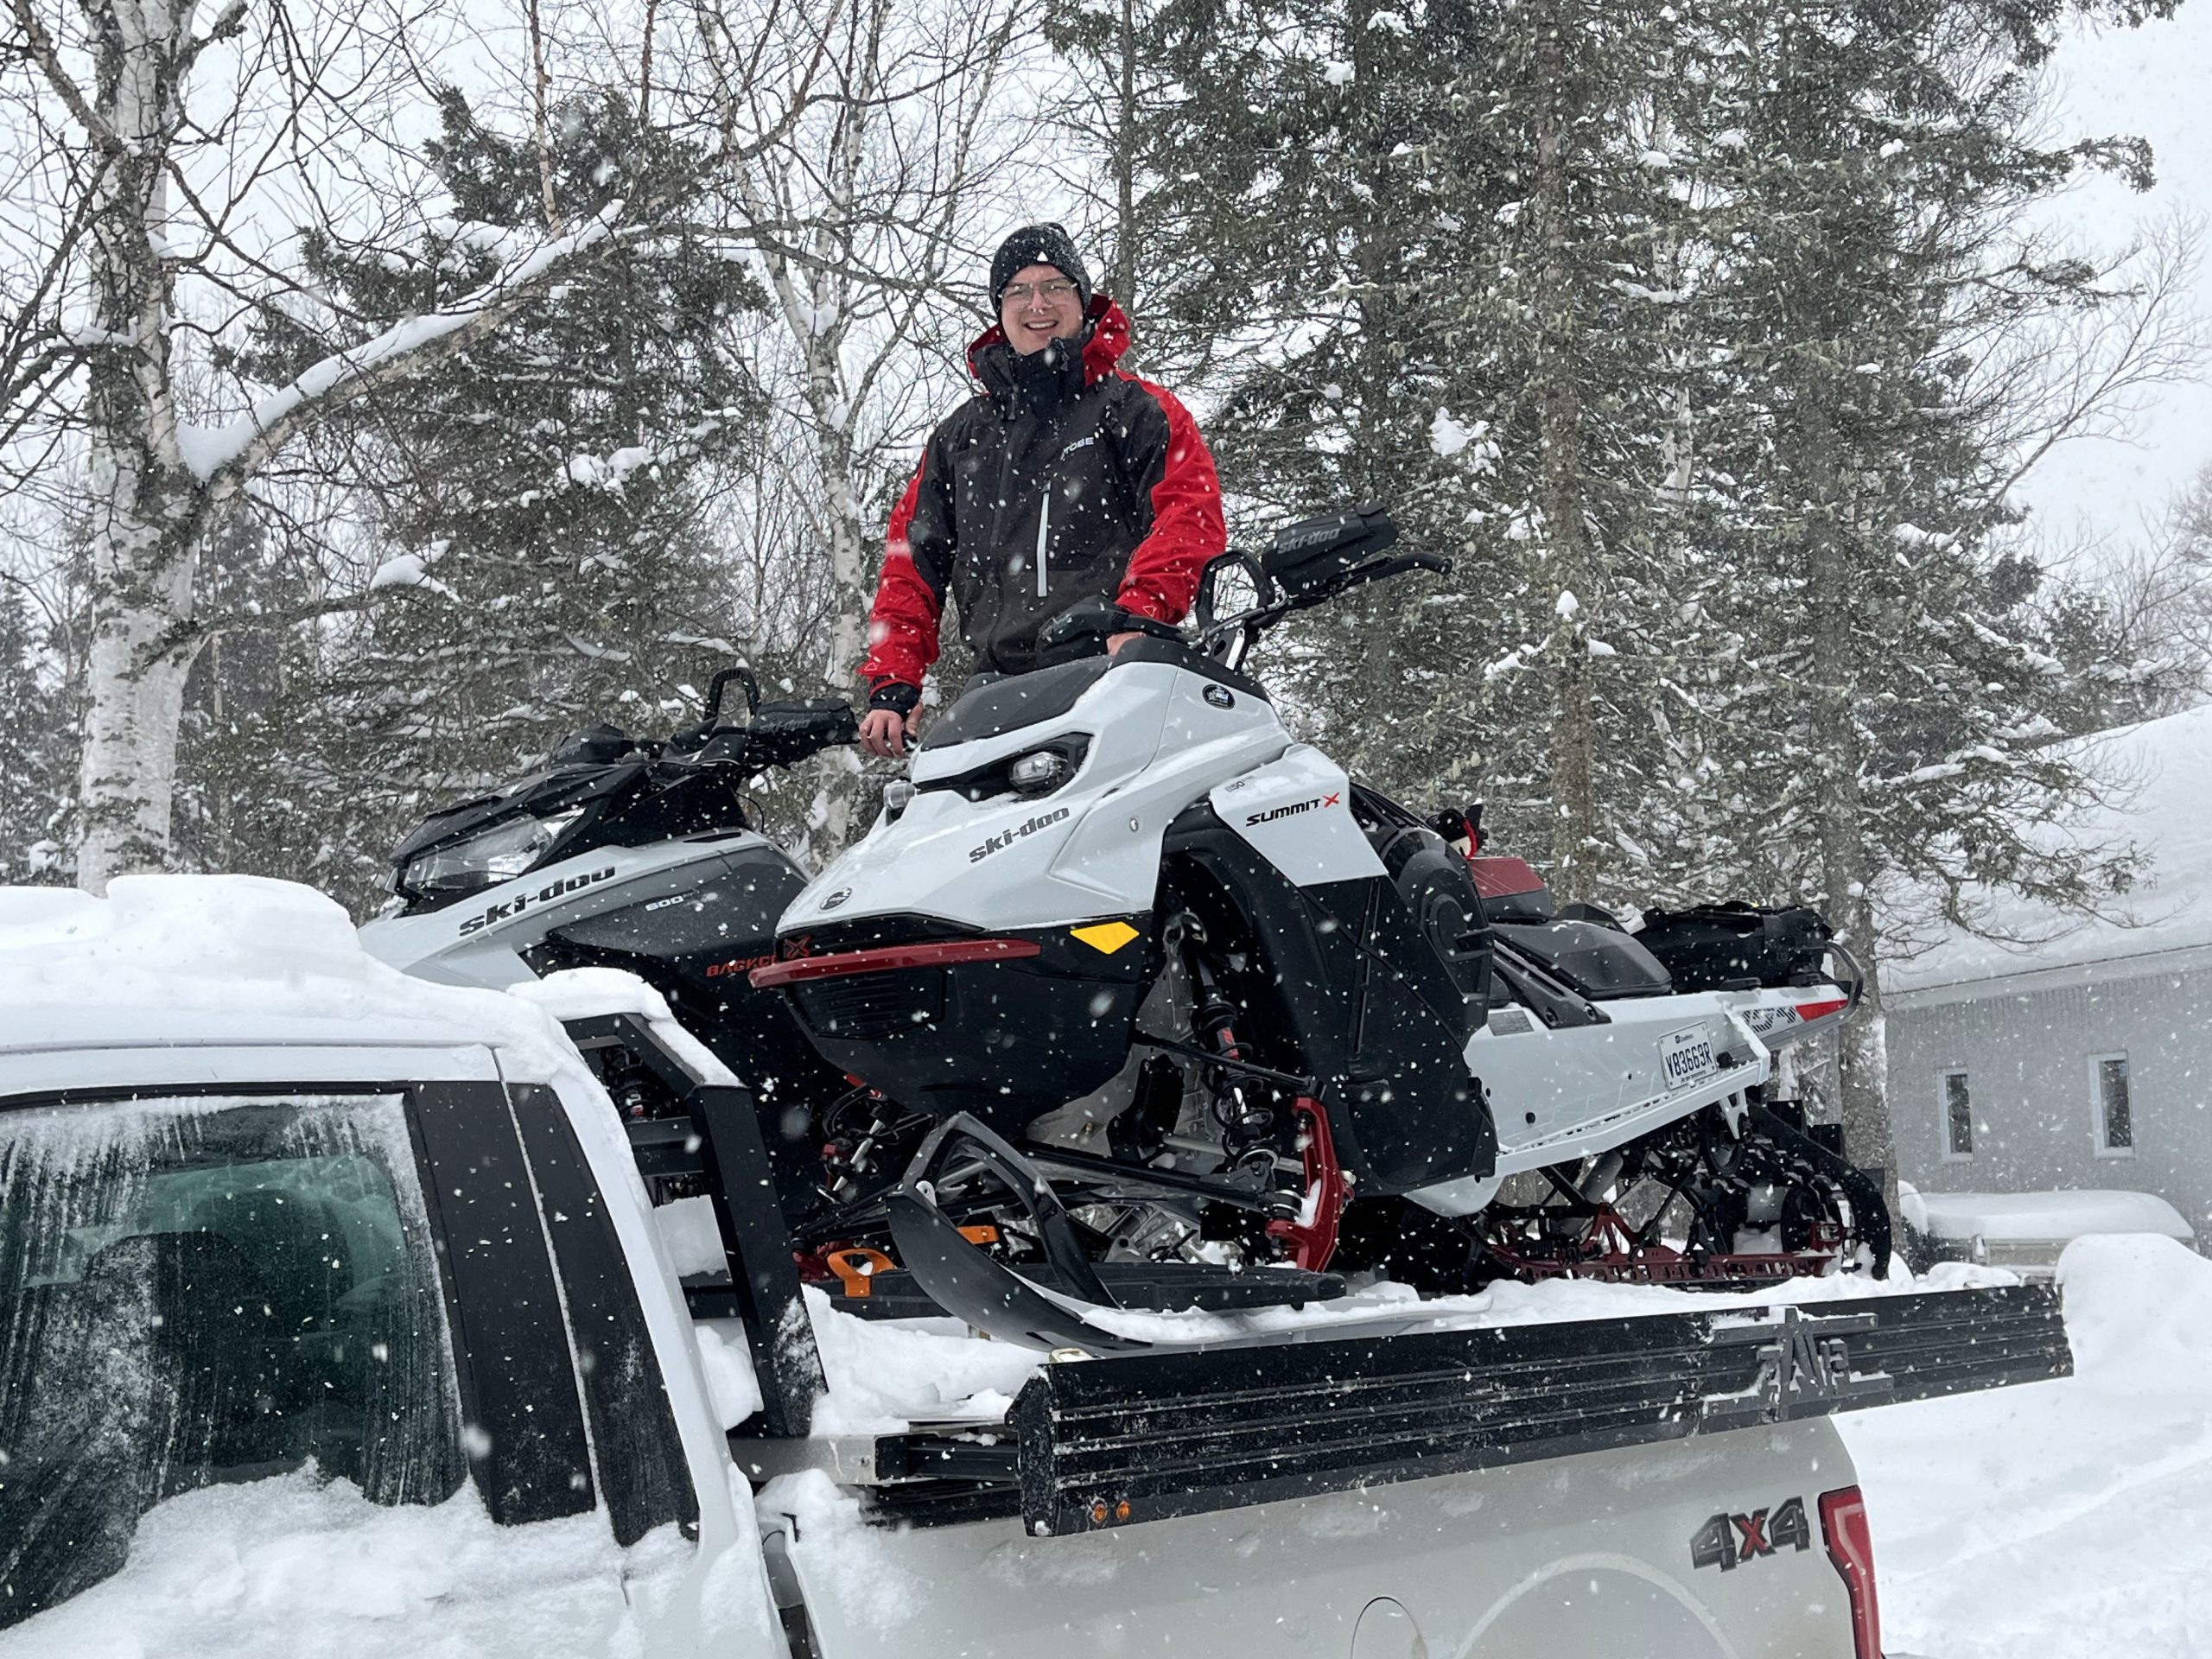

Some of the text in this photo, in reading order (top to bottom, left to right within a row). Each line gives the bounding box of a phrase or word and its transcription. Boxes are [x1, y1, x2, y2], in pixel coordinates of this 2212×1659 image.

[1322, 791, 1340, 808] X
[969, 807, 1070, 863] ski-doo
[459, 866, 615, 937] ski-doo
